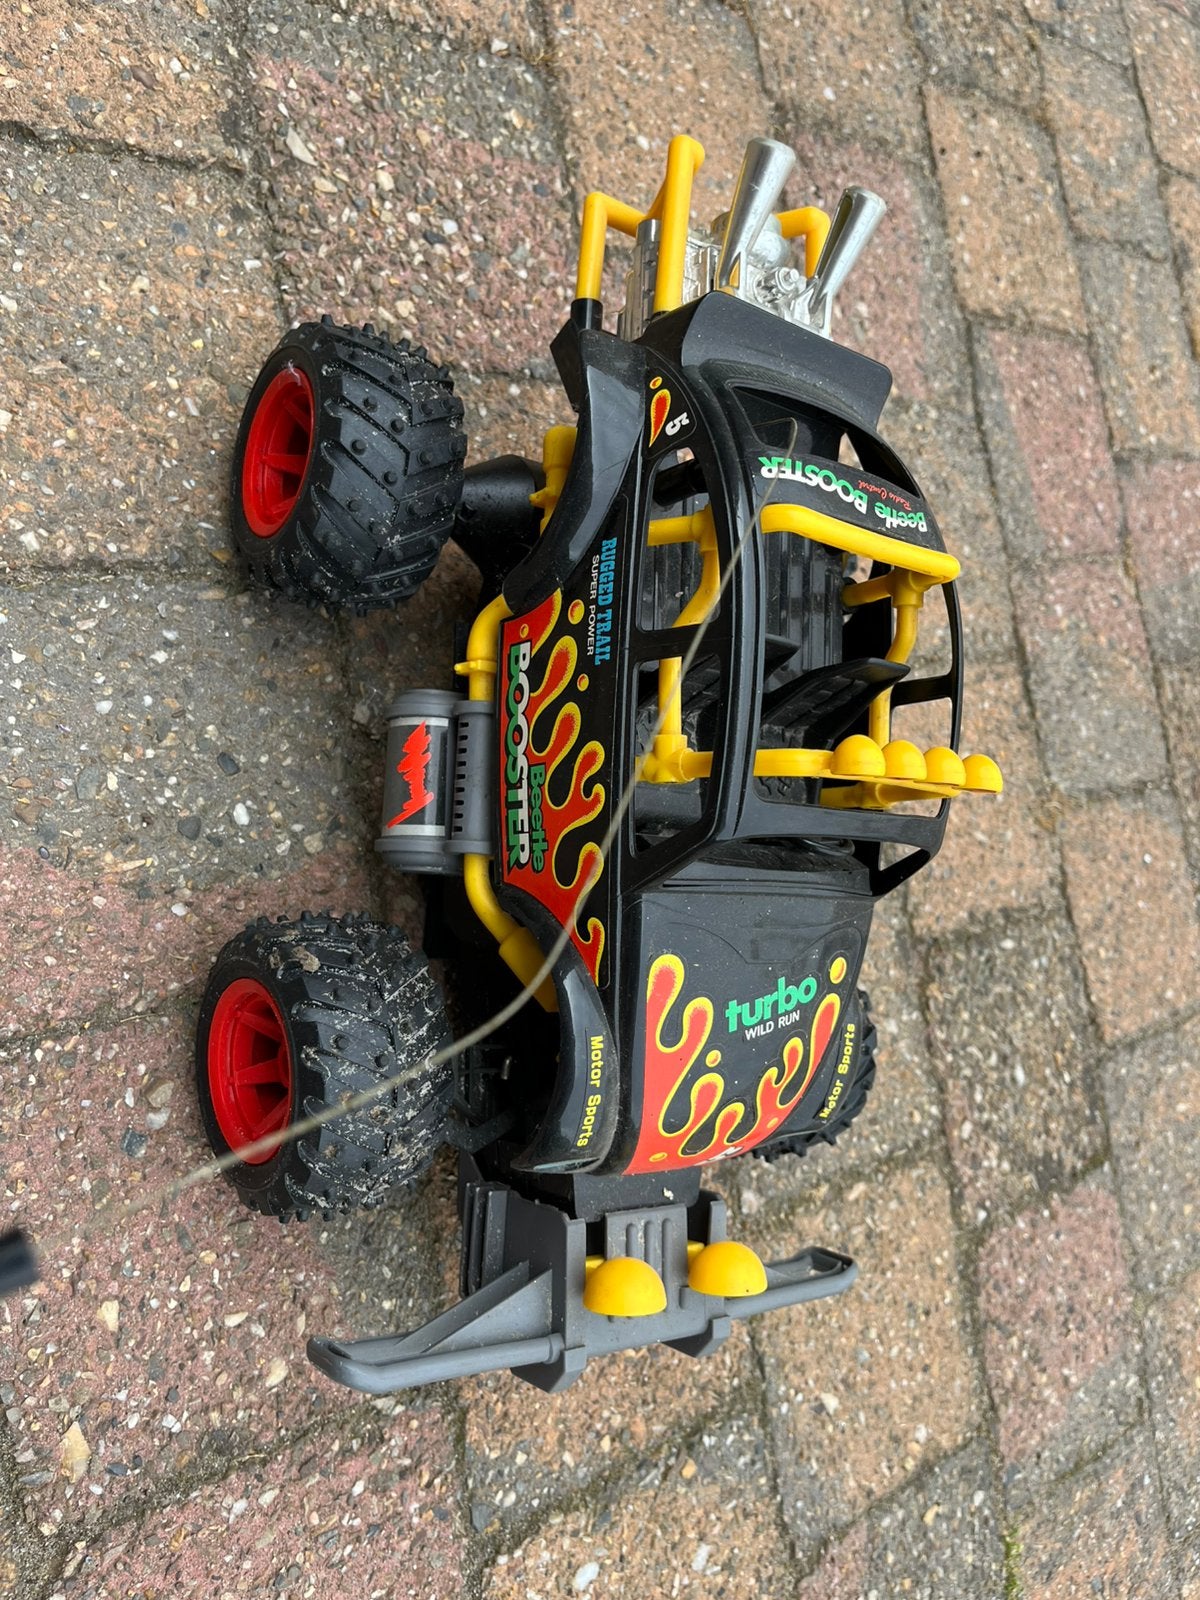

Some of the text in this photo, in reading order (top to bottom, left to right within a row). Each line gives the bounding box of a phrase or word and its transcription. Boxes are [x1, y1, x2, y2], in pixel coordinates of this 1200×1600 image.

[665, 411, 690, 436] 5
[758, 456, 928, 532] Beetle BOOSTER
[888, 492, 912, 511] Radio
[587, 554, 599, 656] SUPER POWER
[595, 537, 617, 666] RUGGED TRAIL
[506, 640, 532, 874] BOOSTER
[530, 764, 548, 873] Beetle
[725, 976, 818, 1033] turbo
[744, 1010, 800, 1041] WILD RUN
[577, 1035, 604, 1147] Motor Sports
[819, 1023, 856, 1119] Motor Sports
